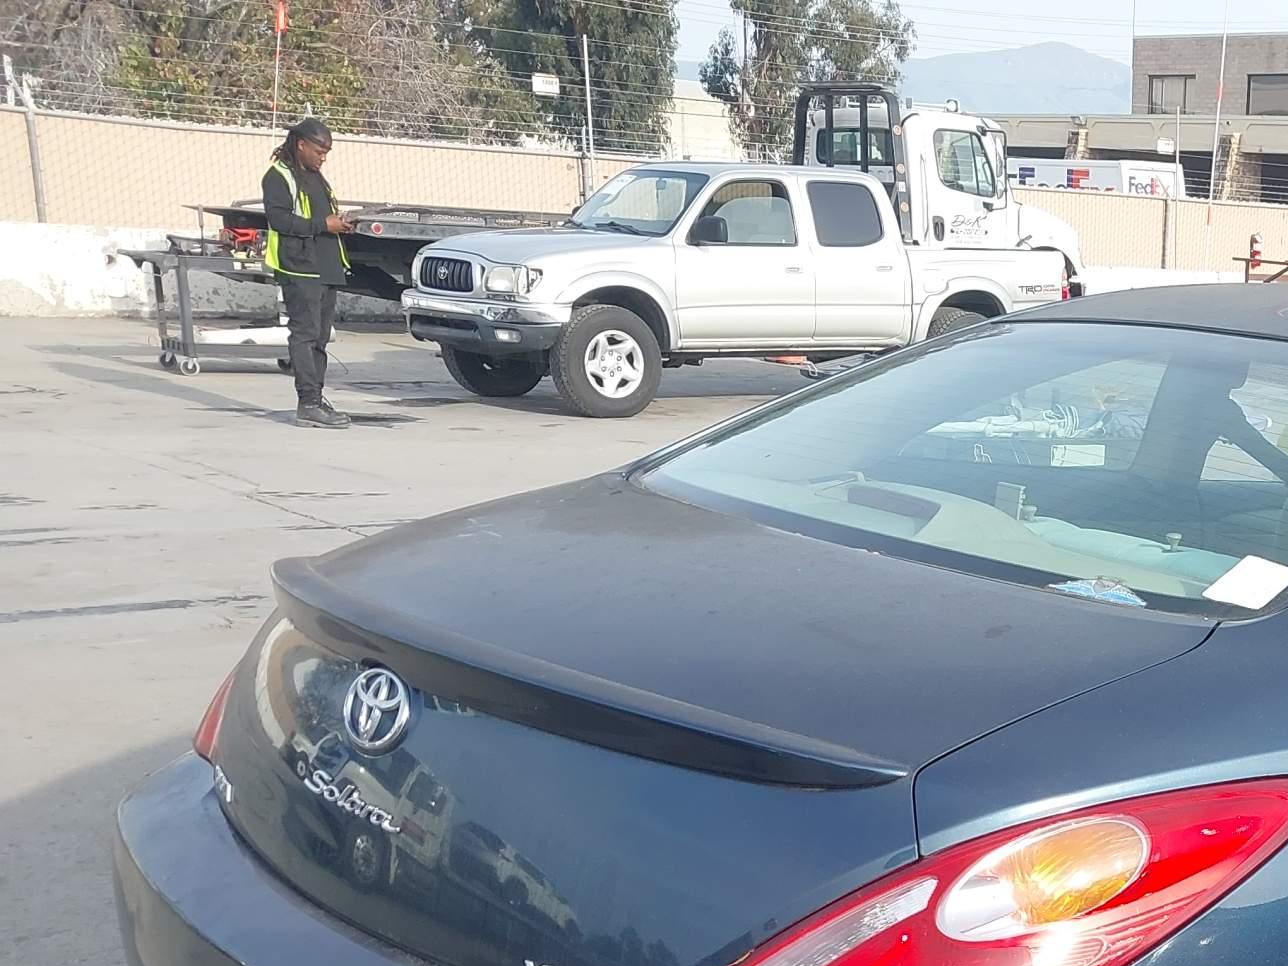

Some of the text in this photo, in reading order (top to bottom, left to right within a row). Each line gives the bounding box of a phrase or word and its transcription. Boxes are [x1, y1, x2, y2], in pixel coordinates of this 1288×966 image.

[1128, 175, 1170, 198] FedEx
[1018, 285, 1042, 294] TRD
[303, 769, 400, 833] Solara
